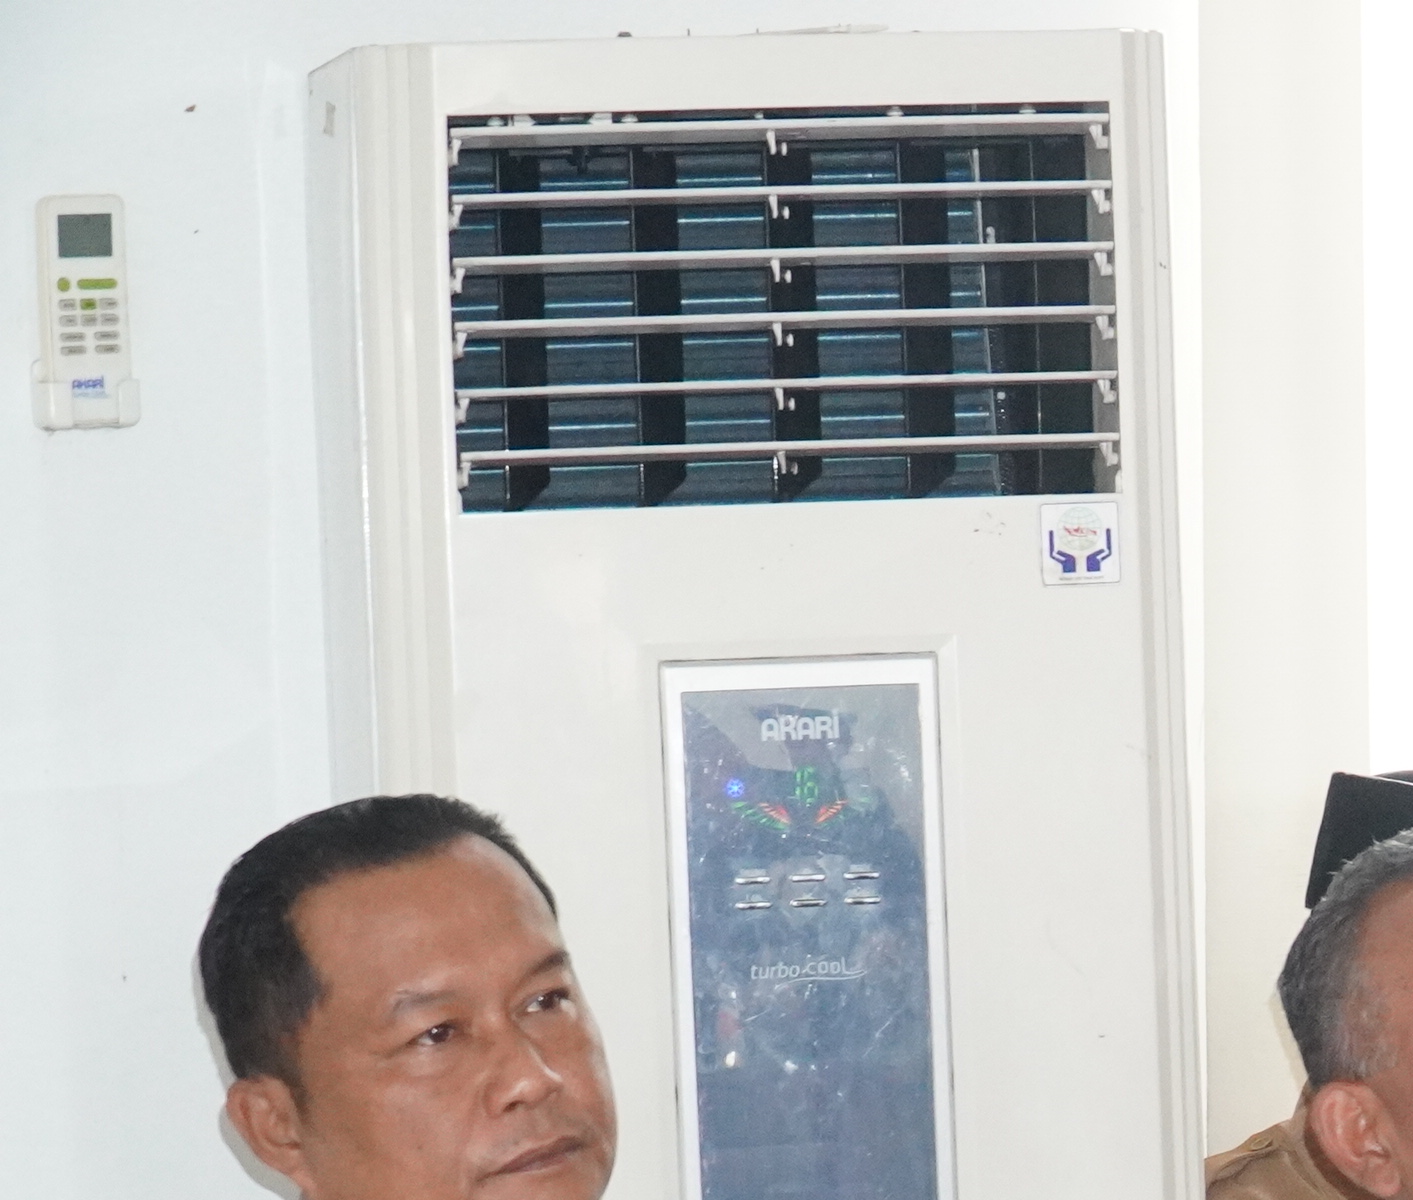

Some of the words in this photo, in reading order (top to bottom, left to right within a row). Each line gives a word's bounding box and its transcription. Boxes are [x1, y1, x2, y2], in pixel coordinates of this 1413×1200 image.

[761, 709, 840, 741] AKARI
[751, 961, 800, 980] turbo
[802, 957, 866, 975] cool
